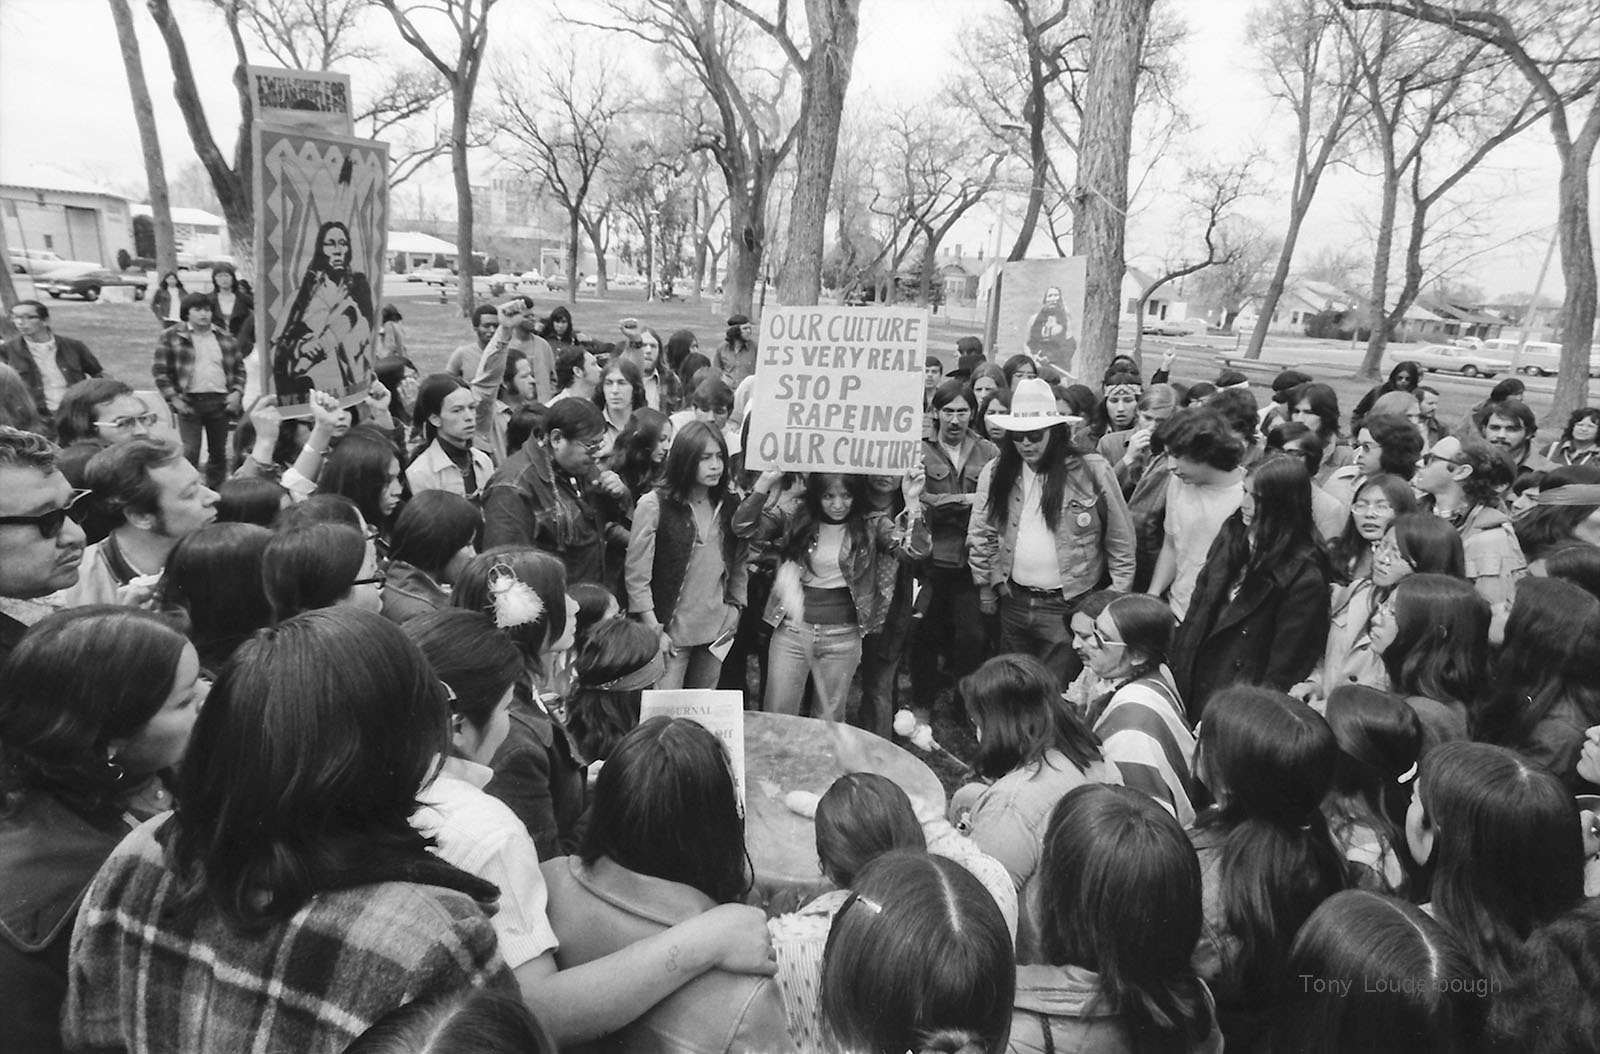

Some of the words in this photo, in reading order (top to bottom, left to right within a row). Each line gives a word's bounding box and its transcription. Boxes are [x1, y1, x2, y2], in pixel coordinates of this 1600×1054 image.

[324, 81, 346, 99] FOR
[770, 313, 823, 341] OUR
[827, 315, 921, 343] CULTURE
[763, 345, 794, 366] IS
[801, 345, 864, 369] VERY
[867, 348, 923, 373] REAL
[775, 374, 862, 401] STOP
[786, 402, 914, 434] RAPEING
[759, 431, 825, 465] OUR
[832, 436, 924, 470] CULTURE
